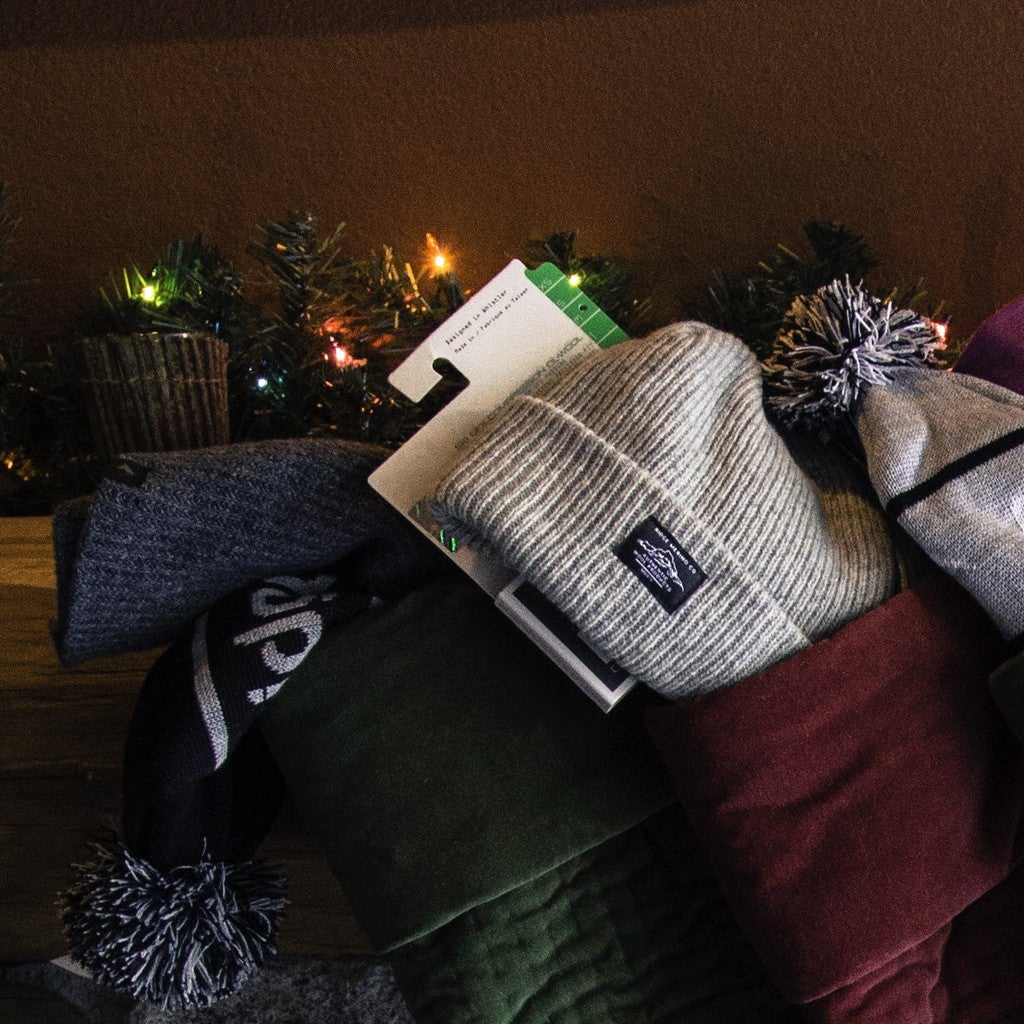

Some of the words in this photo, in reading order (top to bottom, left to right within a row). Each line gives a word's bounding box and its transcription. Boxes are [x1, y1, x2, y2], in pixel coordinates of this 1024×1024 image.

[511, 288, 528, 302] Taiwan
[445, 321, 473, 345] Designed
[472, 313, 481, 321] in
[481, 290, 507, 313] Whistler
[654, 527, 670, 543] RIDGE
[669, 543, 689, 566] MERINO
